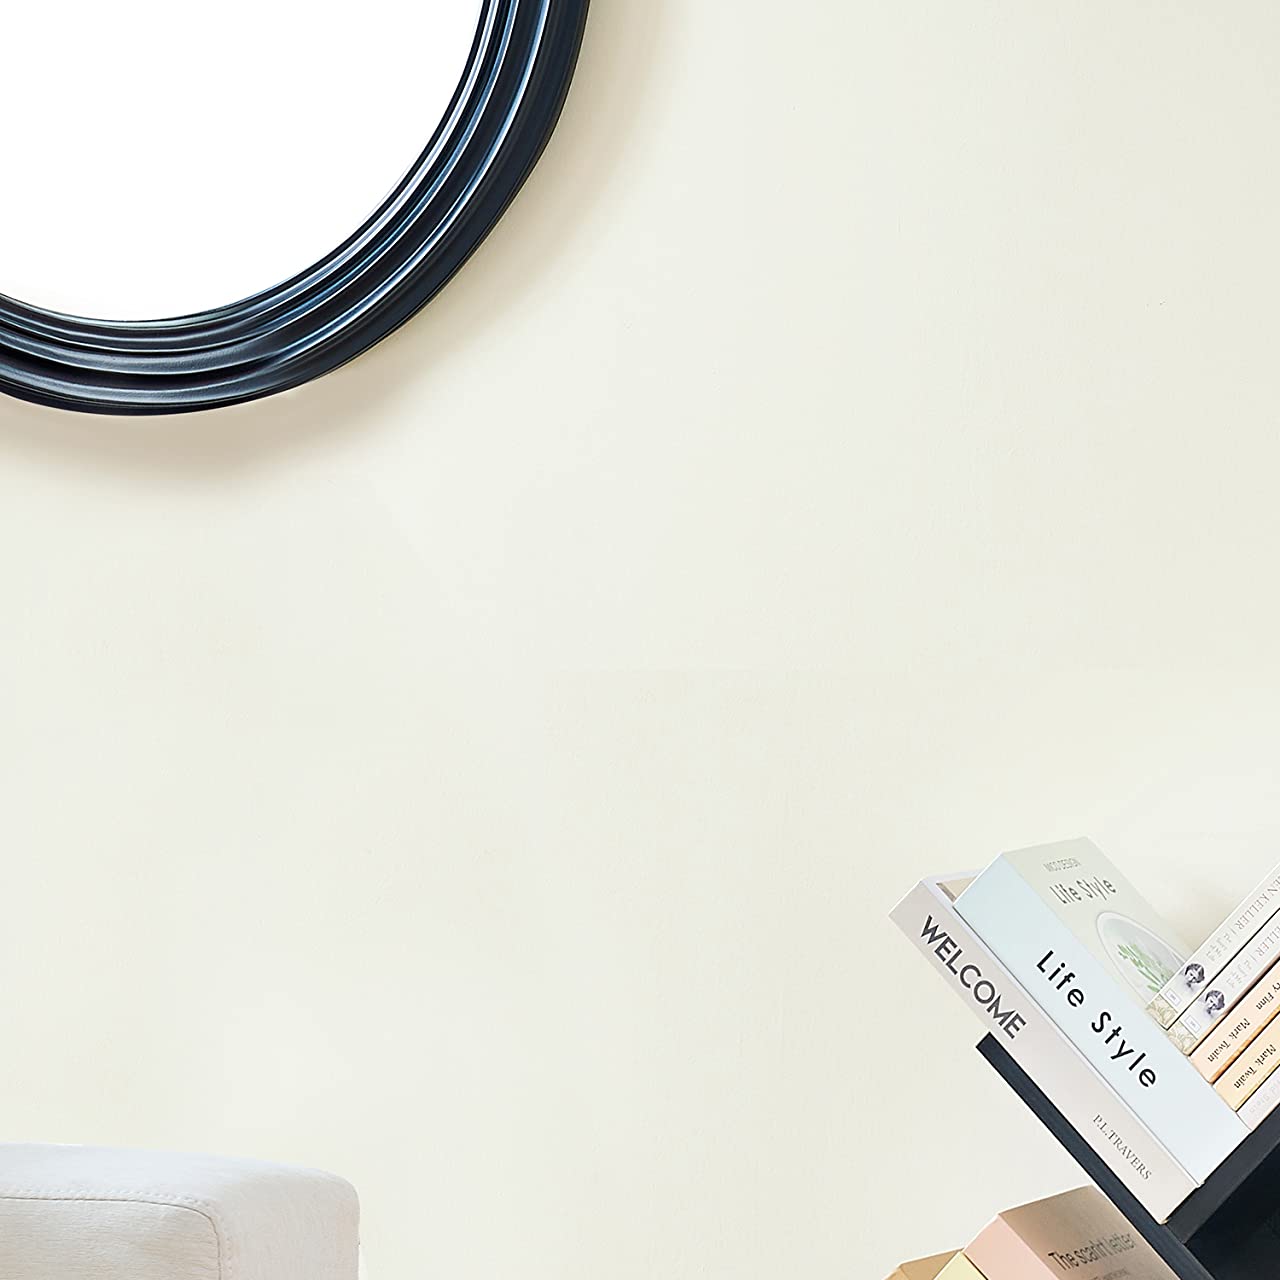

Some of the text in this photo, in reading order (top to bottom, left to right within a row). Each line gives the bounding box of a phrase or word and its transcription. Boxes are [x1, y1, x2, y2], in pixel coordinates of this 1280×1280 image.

[1049, 876, 1116, 904] Life Style
[1234, 892, 1269, 930] KELLER
[918, 914, 1027, 1040] WELCOME
[1255, 991, 1274, 1010] Finn
[1035, 950, 1158, 1090] Life Style
[1228, 1017, 1251, 1040] Mark
[1207, 1039, 1231, 1063] Twain
[1233, 1044, 1277, 1089] Mark Twain
[1092, 1114, 1152, 1180] P.L.TRAVERS
[1048, 1252, 1080, 1271] The
